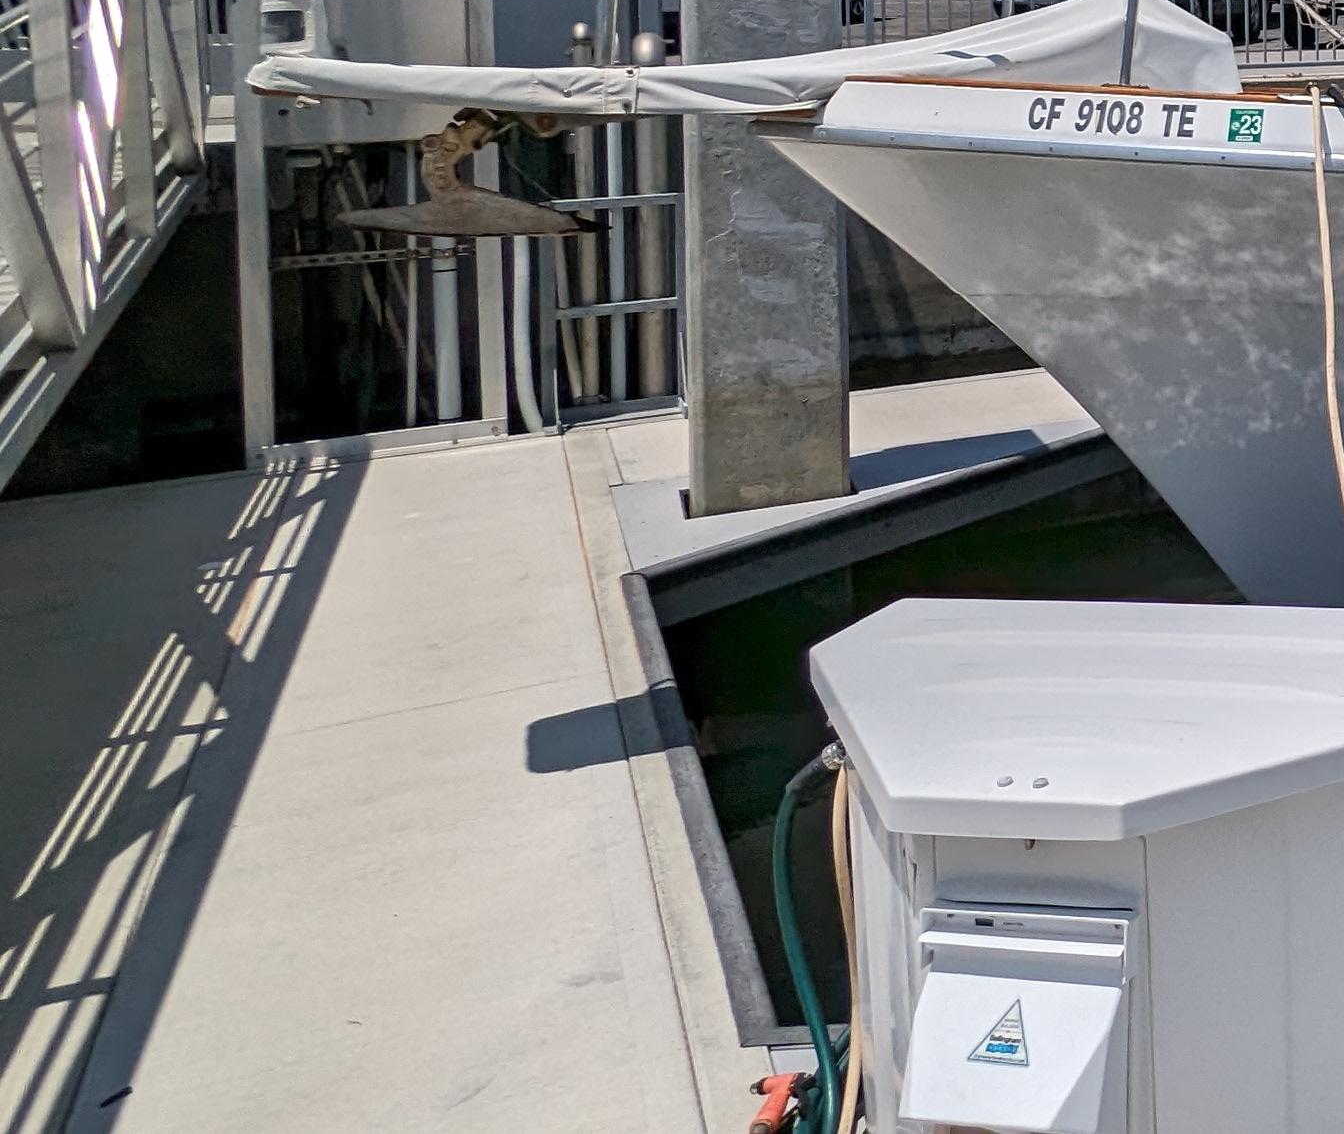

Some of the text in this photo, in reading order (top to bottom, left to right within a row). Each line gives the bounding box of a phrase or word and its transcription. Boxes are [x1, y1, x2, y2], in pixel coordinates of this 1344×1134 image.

[1028, 97, 1198, 138] CF 9108 TE
[1239, 115, 1262, 135] 23
